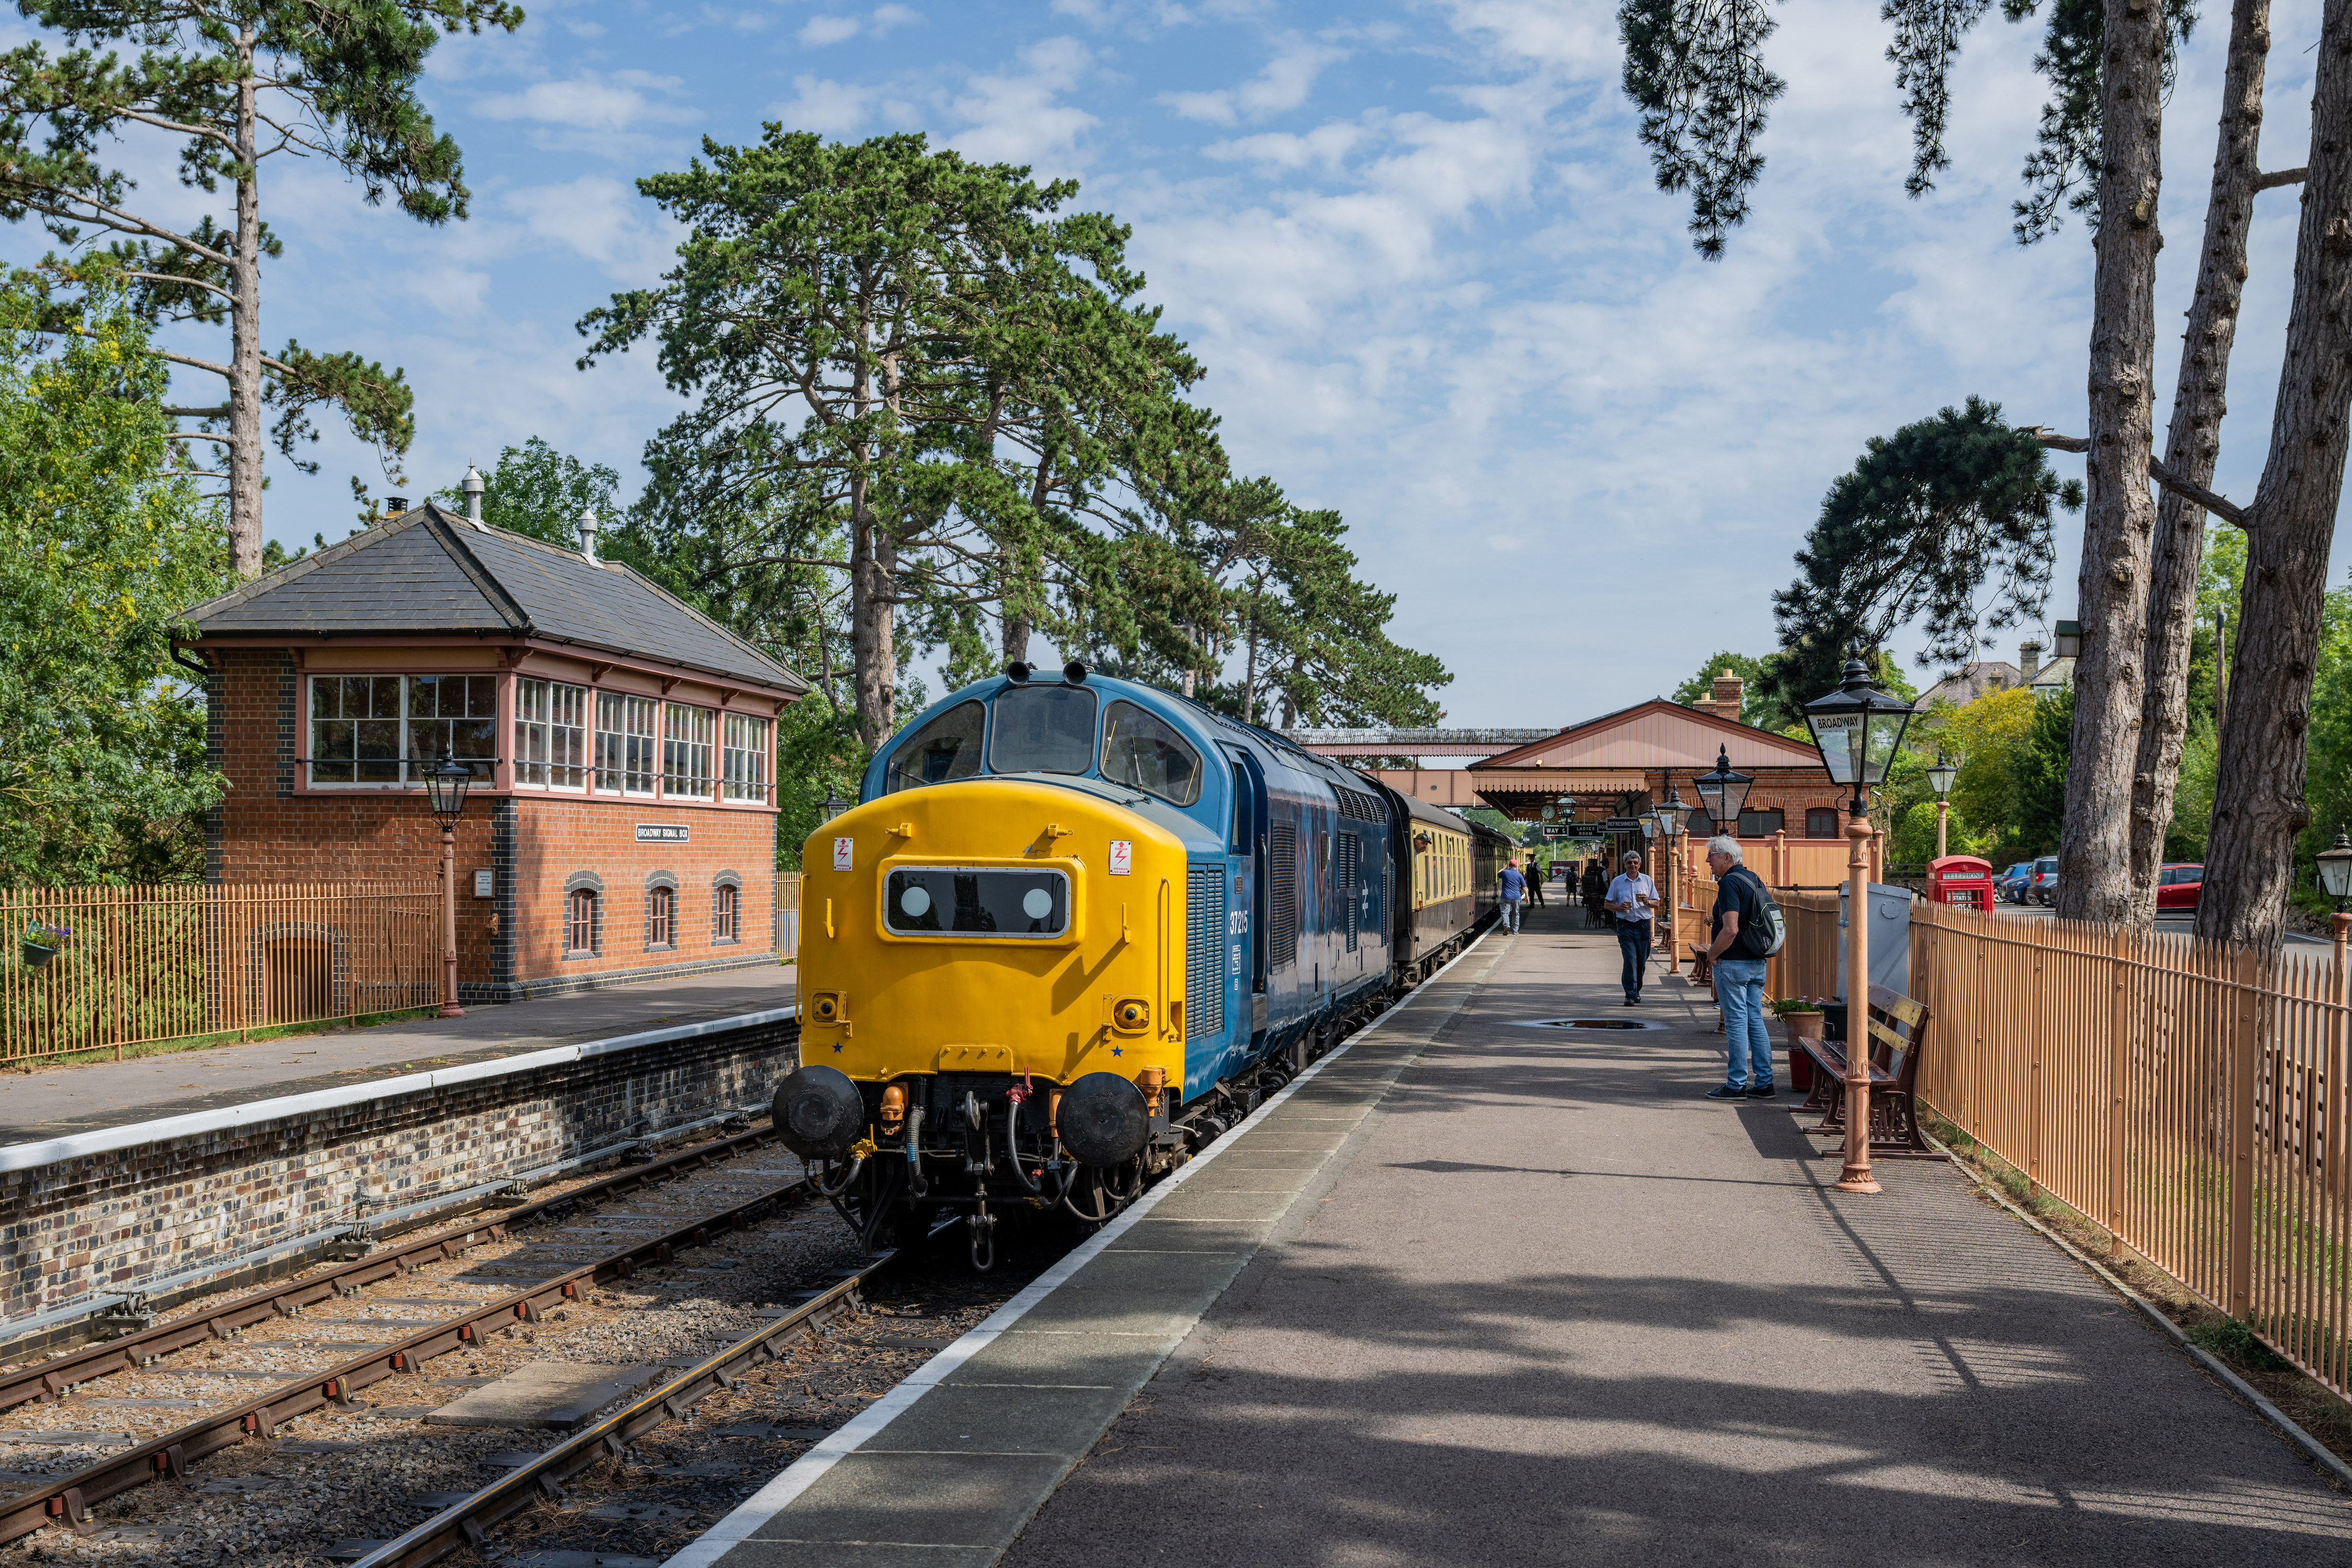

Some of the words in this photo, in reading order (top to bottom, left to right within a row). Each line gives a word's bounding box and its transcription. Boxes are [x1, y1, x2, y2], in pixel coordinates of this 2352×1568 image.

[1817, 717, 1858, 729] BROADWAY
[638, 828, 661, 837] BROADWAY
[663, 829, 678, 837] SIGNAL
[1230, 910, 1248, 935] 37215
